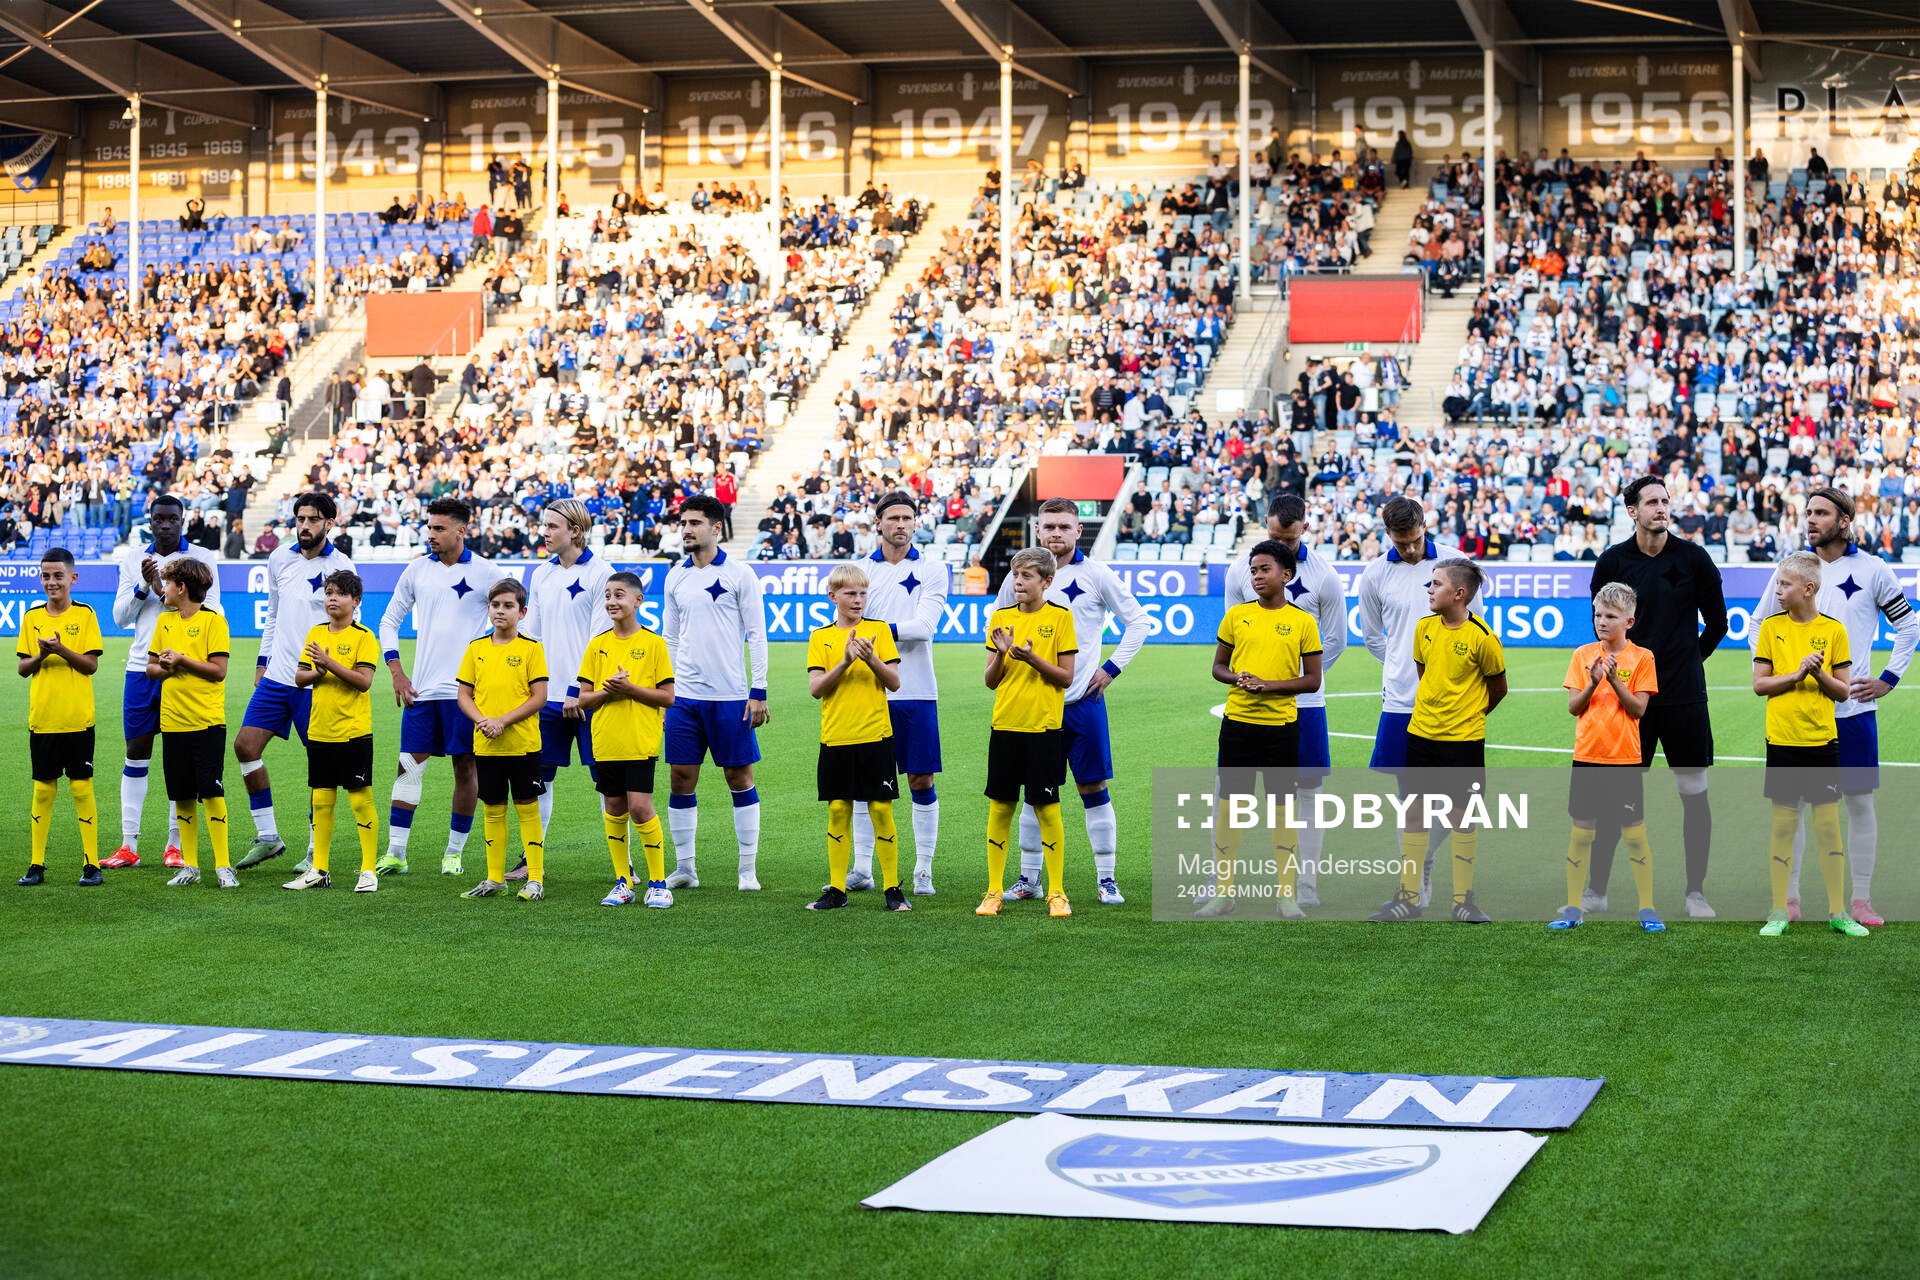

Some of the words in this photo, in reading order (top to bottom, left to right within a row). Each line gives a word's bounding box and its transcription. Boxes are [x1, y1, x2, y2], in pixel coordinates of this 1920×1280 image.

[1117, 76, 1174, 88] SVENSKA
[1203, 72, 1264, 85] MÄSTRE
[1341, 70, 1399, 82] SVENSKA
[1429, 66, 1485, 81] MÄSTAR
[1568, 65, 1628, 78] SVENSKA
[688, 90, 742, 102] SVENSKA
[781, 85, 825, 98] ÄSTARE
[898, 82, 953, 94] SVENSKA
[982, 79, 1040, 91] MÄTARE
[284, 108, 334, 119] SVENA
[470, 97, 527, 109] SVENSKA
[108, 117, 158, 130] SVSKA
[891, 104, 1048, 159] 1947
[1107, 99, 1275, 154] 1948
[1332, 94, 1503, 149] 1952
[1558, 91, 1732, 146] 1956
[95, 145, 131, 161] 1943
[150, 143, 188, 157] 1945
[202, 140, 243, 155] 1969
[461, 118, 626, 172] 1945
[678, 111, 838, 166] 1946
[275, 126, 421, 180] 1943
[150, 171, 186, 186] 1991
[200, 169, 241, 185] 1994
[1113, 570, 1185, 597] ISO
[768, 602, 838, 633] XIS
[1483, 605, 1564, 639] ISO
[0, 1028, 1517, 1125] ALLSVENSKAN
[1096, 1143, 1247, 1161] IFK
[1092, 1154, 1414, 1183] NORRKÖPING
